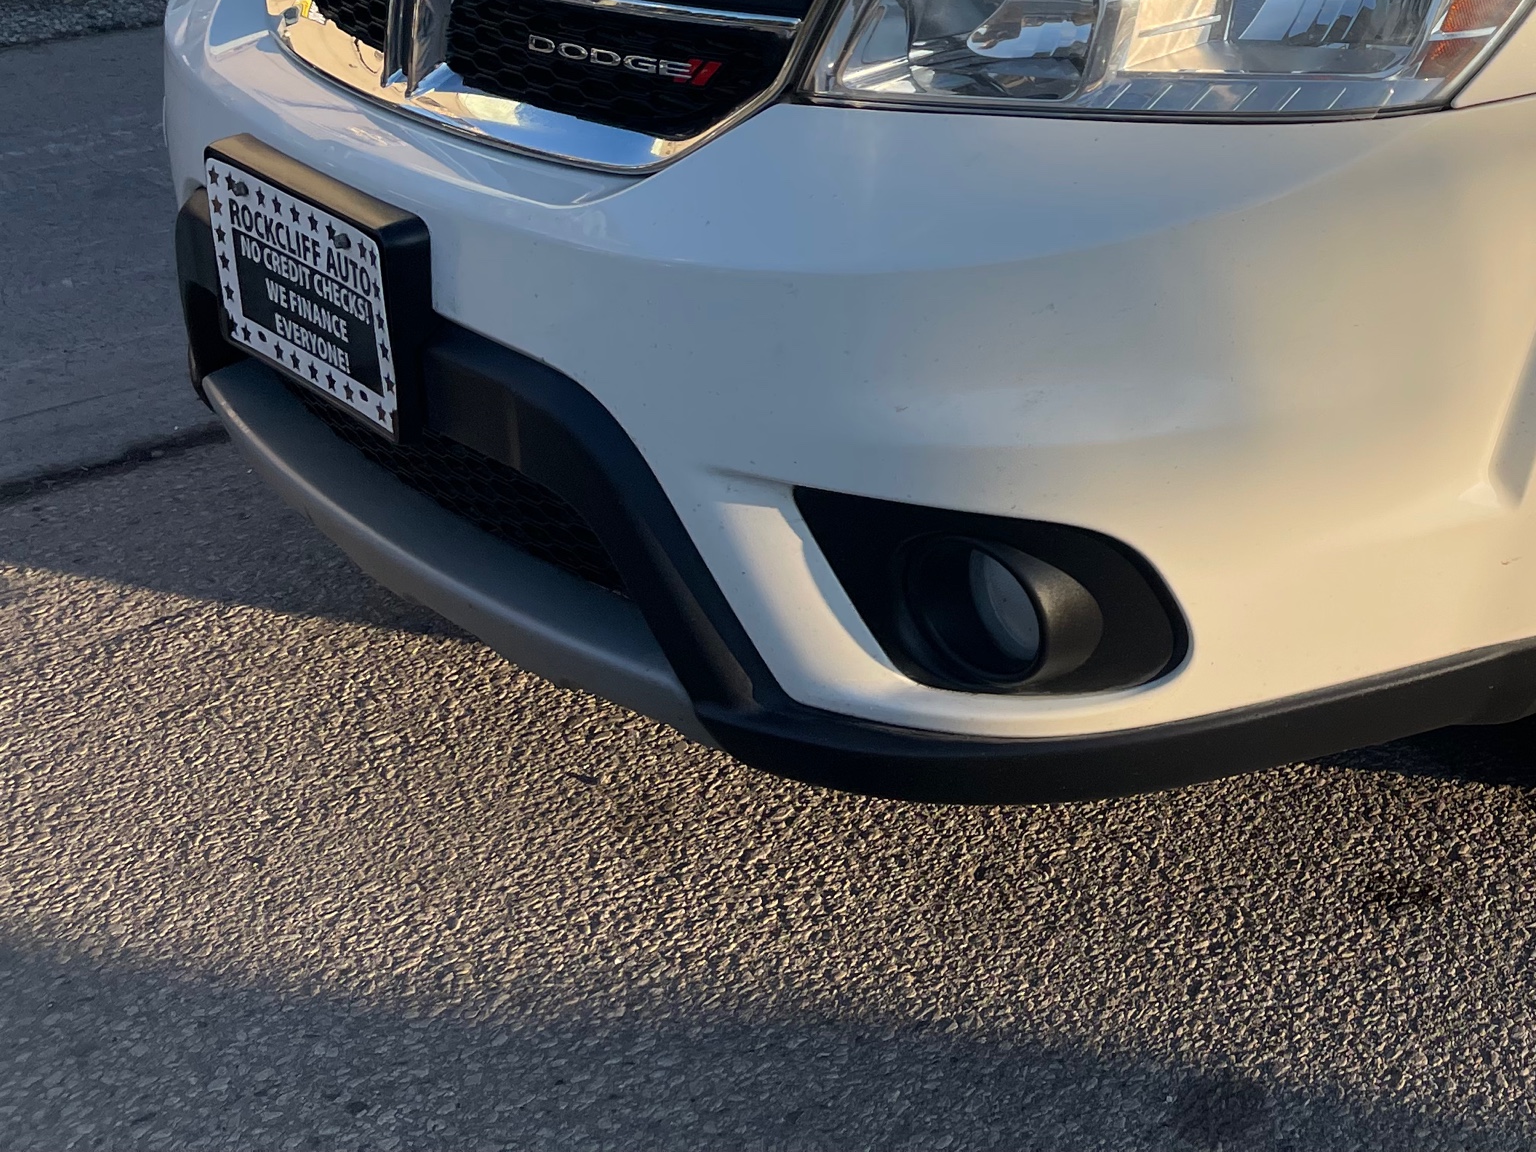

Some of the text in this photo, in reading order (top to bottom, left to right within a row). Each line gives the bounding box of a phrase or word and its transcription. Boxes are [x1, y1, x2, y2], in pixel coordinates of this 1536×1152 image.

[528, 34, 692, 79] DODGE
[228, 198, 370, 297] ROCKCLIFF AUTO
[240, 235, 370, 324] NO CREDIT CHECKS!
[265, 278, 348, 343] WE FINANCE
[274, 313, 351, 374] EVERYONE!
